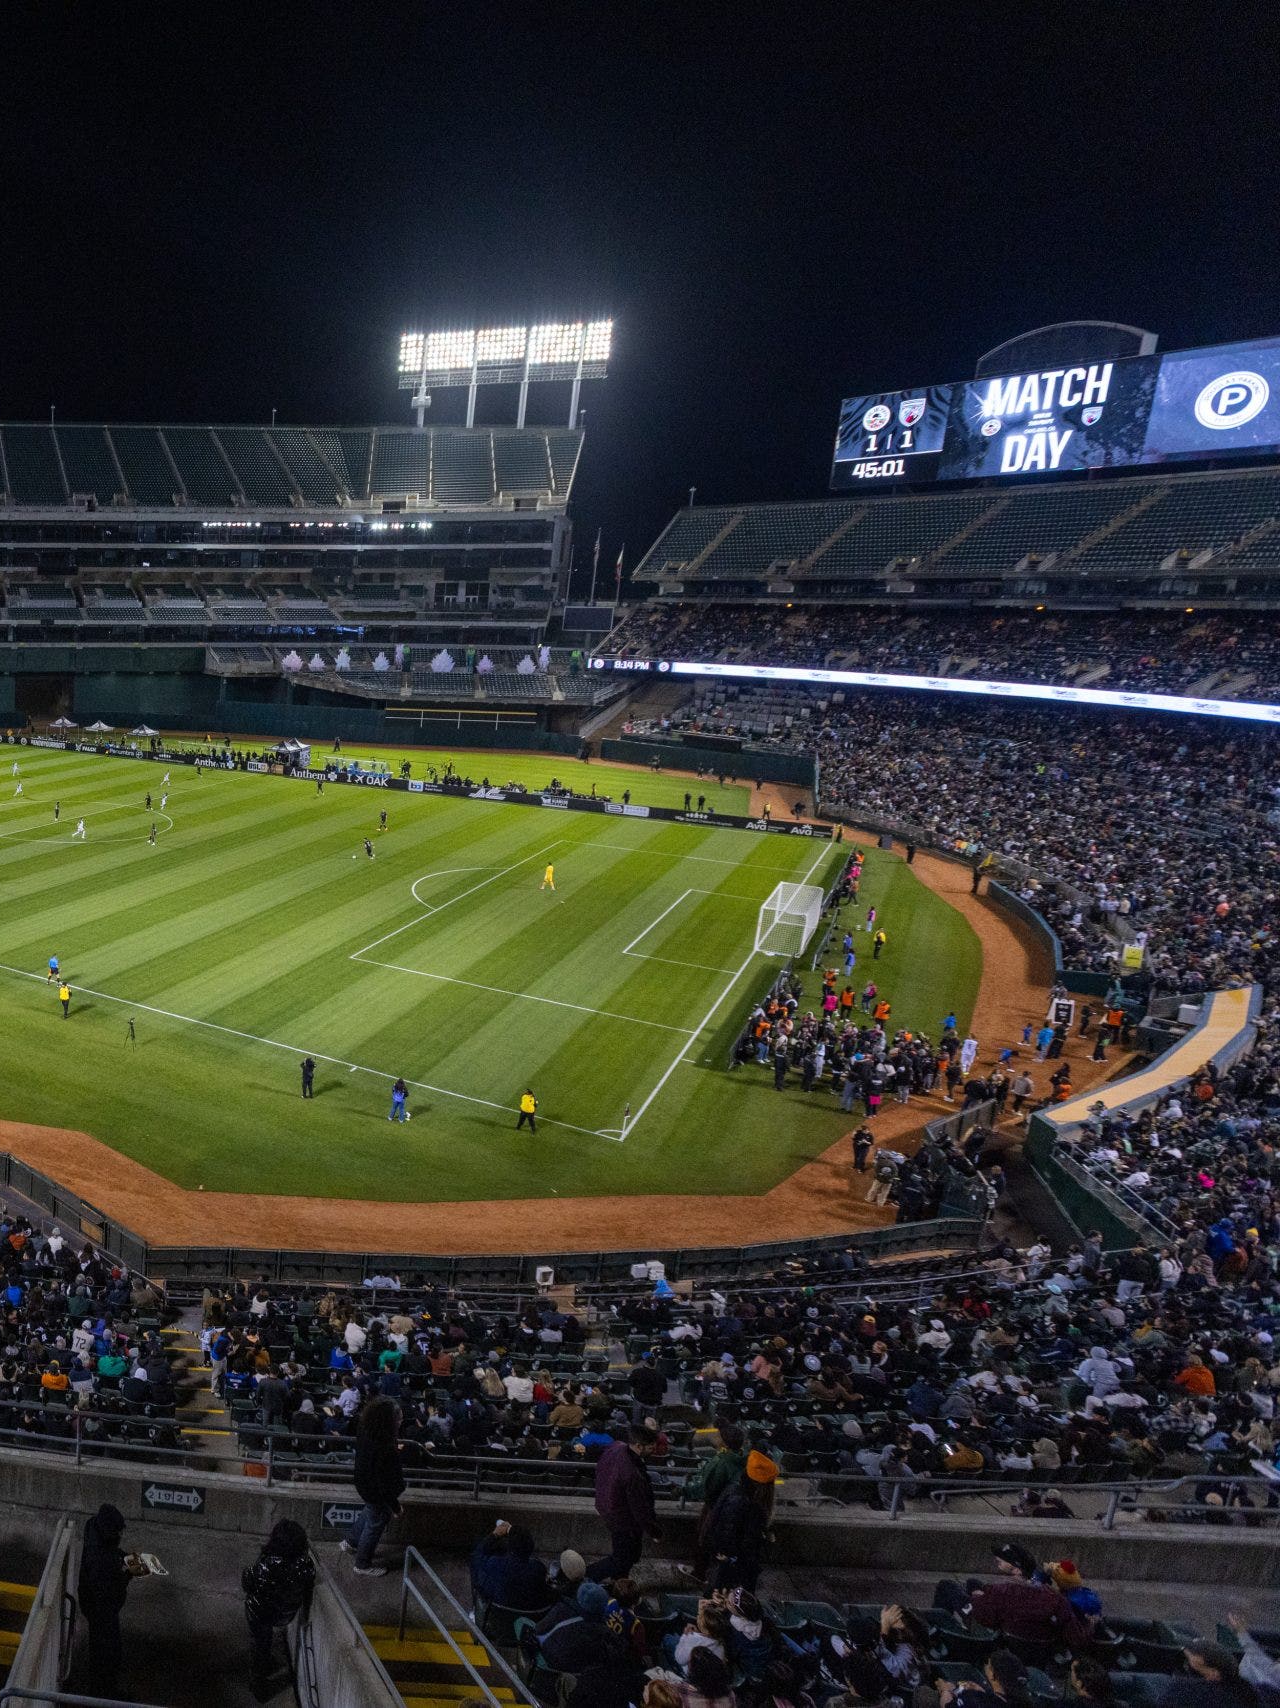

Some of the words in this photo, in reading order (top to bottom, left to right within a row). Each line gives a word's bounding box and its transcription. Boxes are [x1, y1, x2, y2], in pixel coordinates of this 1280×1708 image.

[984, 362, 1113, 417] MATCH
[1217, 387, 1247, 415] P
[866, 434, 878, 452] 1
[900, 431, 913, 448] 1
[1000, 430, 1073, 473] DAY
[852, 459, 905, 478] 45:01
[614, 660, 633, 669] 8:14
[634, 661, 649, 670] PM
[290, 767, 326, 780] Anthem
[366, 776, 389, 787] OAK
[745, 821, 767, 831] Ava
[790, 826, 812, 836] Ava
[148, 1490, 171, 1501] 219
[330, 1511, 352, 1520] 219
